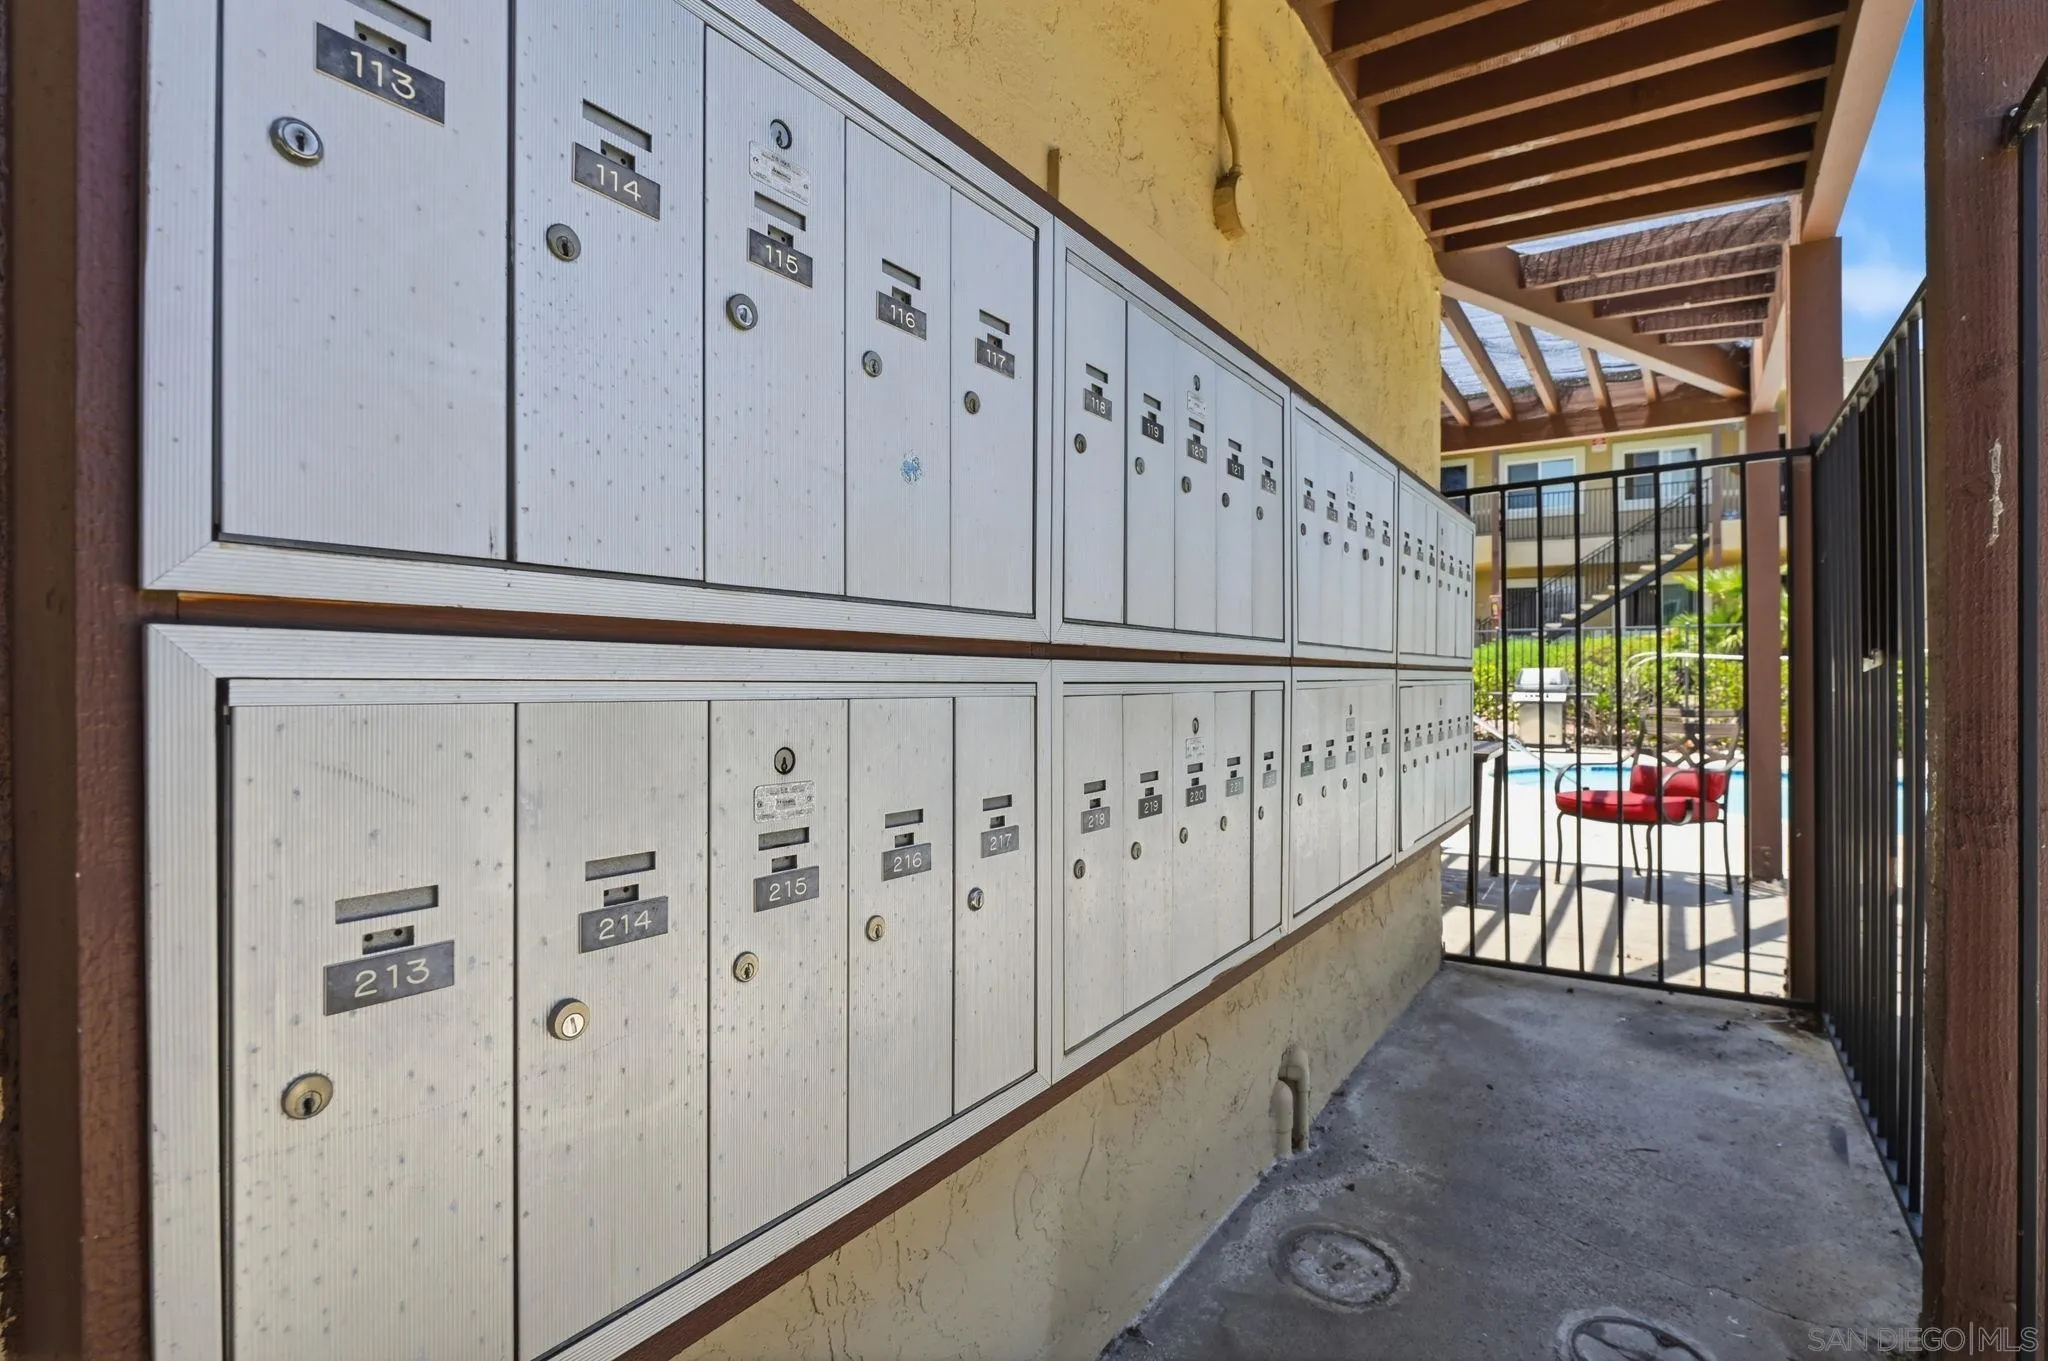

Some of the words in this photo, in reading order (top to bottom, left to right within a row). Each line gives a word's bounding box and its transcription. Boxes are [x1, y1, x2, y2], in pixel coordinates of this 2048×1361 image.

[350, 50, 416, 100] 113
[596, 163, 642, 203] 114
[765, 244, 799, 275] 115
[890, 304, 916, 329] 116
[986, 348, 1006, 368] 117
[1091, 397, 1106, 415] 118
[1147, 423, 1159, 438] 119
[1191, 444, 1204, 459] 120
[1231, 463, 1241, 475] 121
[1189, 789, 1204, 802] 220
[1144, 800, 1159, 814] 219
[1088, 812, 1105, 827] 218
[990, 833, 1012, 851] 217
[893, 852, 922, 872] 216
[769, 877, 807, 902] 215
[598, 910, 652, 940] 214
[354, 957, 430, 998] 213
